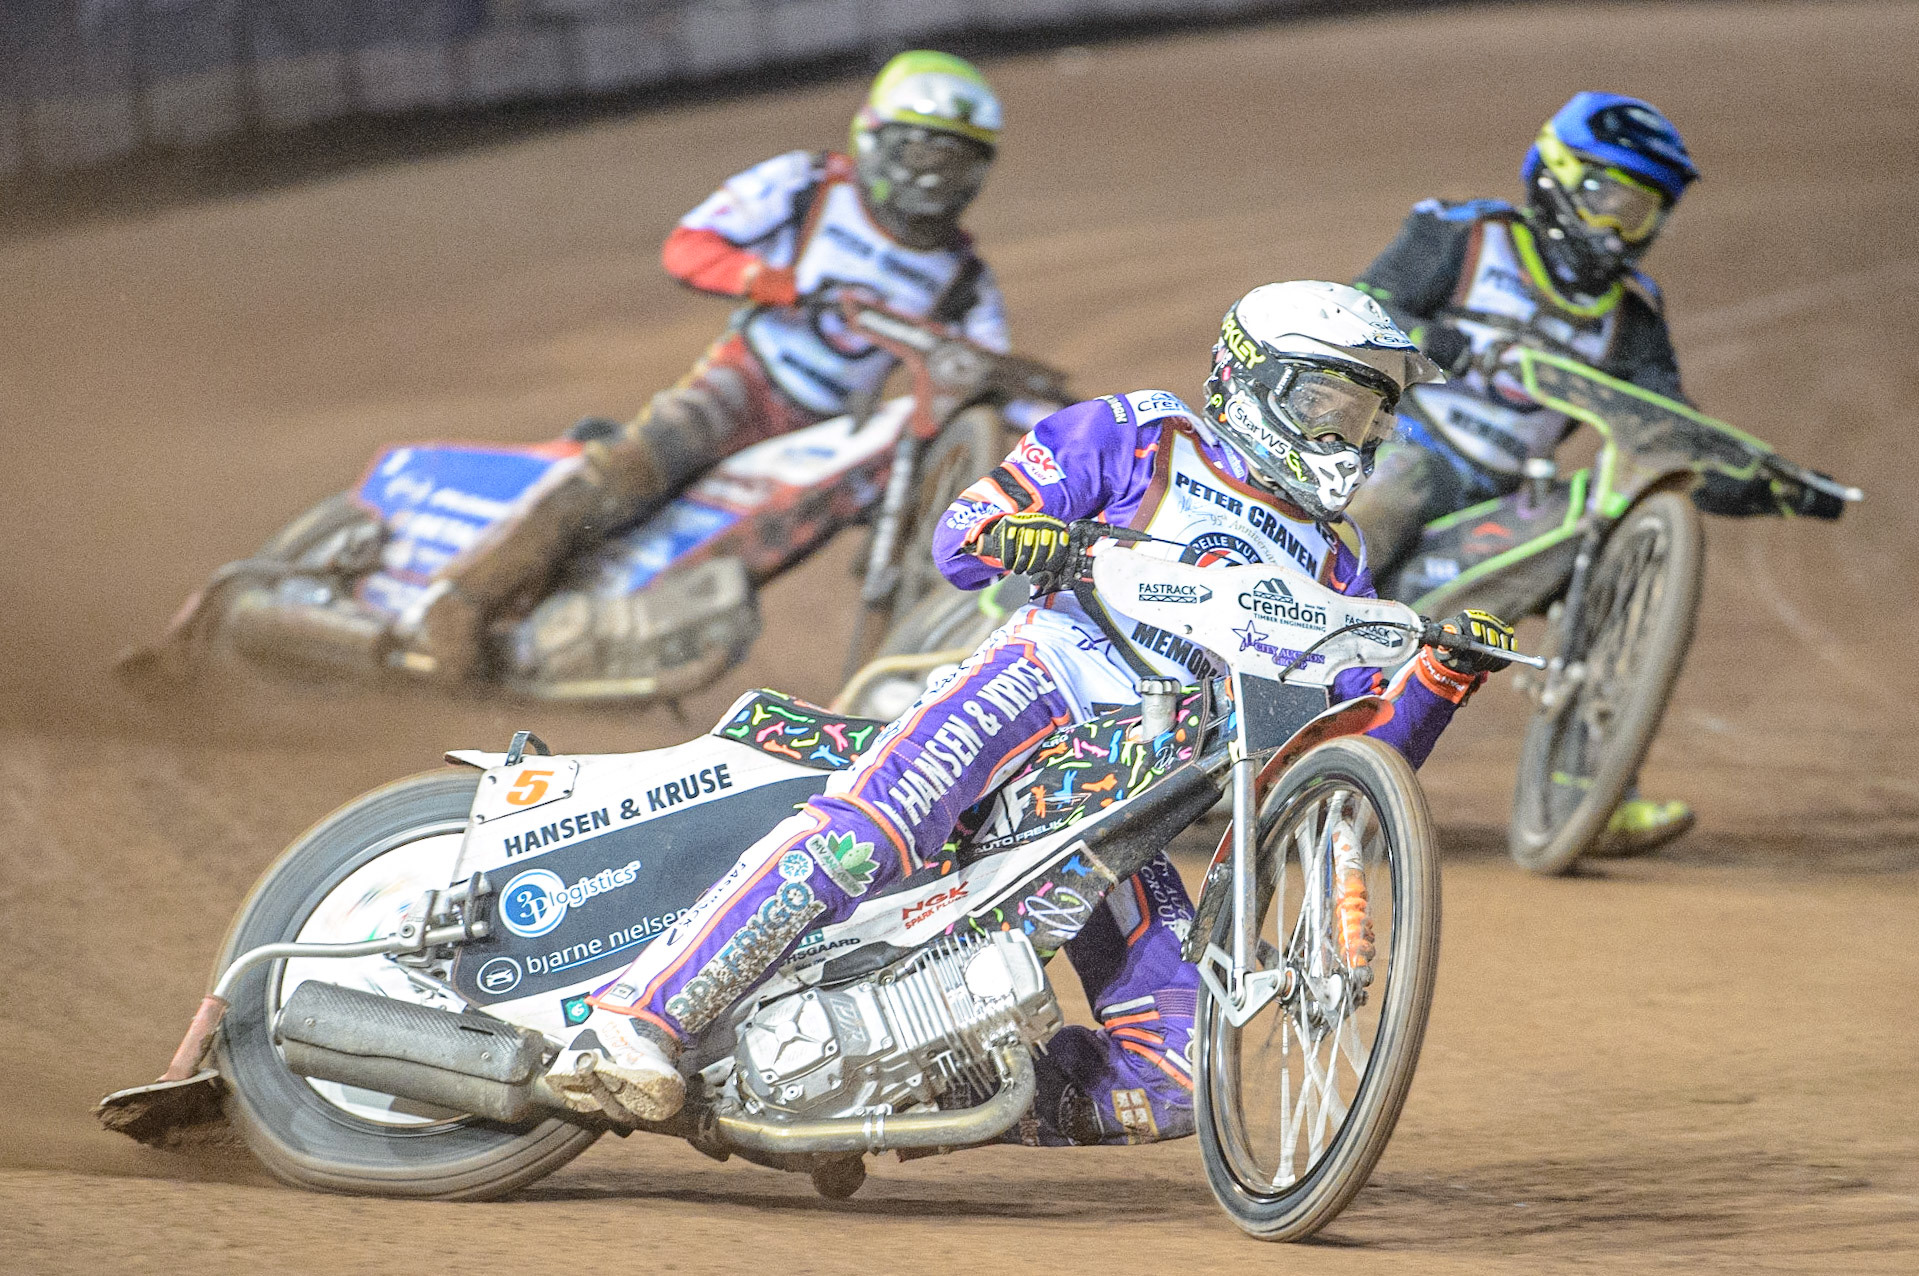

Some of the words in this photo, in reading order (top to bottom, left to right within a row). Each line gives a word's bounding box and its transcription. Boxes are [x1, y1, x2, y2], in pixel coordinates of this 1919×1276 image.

[1175, 471, 1243, 517] PETER
[1248, 505, 1317, 580] CRAVEN
[1139, 583, 1197, 596] FASTRACK
[1238, 592, 1327, 626] Crendon
[1253, 612, 1278, 624] TIMBER
[1279, 618, 1327, 633] ENGINEERING
[1253, 642, 1279, 656] CITY
[889, 714, 984, 826] HANSEN
[962, 700, 1002, 737] &
[506, 770, 555, 806] 5
[503, 808, 611, 857] HANSEN
[620, 798, 641, 820] &
[646, 763, 733, 812] KRUSE
[902, 880, 969, 920] NGK
[904, 908, 935, 930] SPARK
[526, 937, 602, 974] bjarne
[779, 937, 861, 968] HSGAARD
